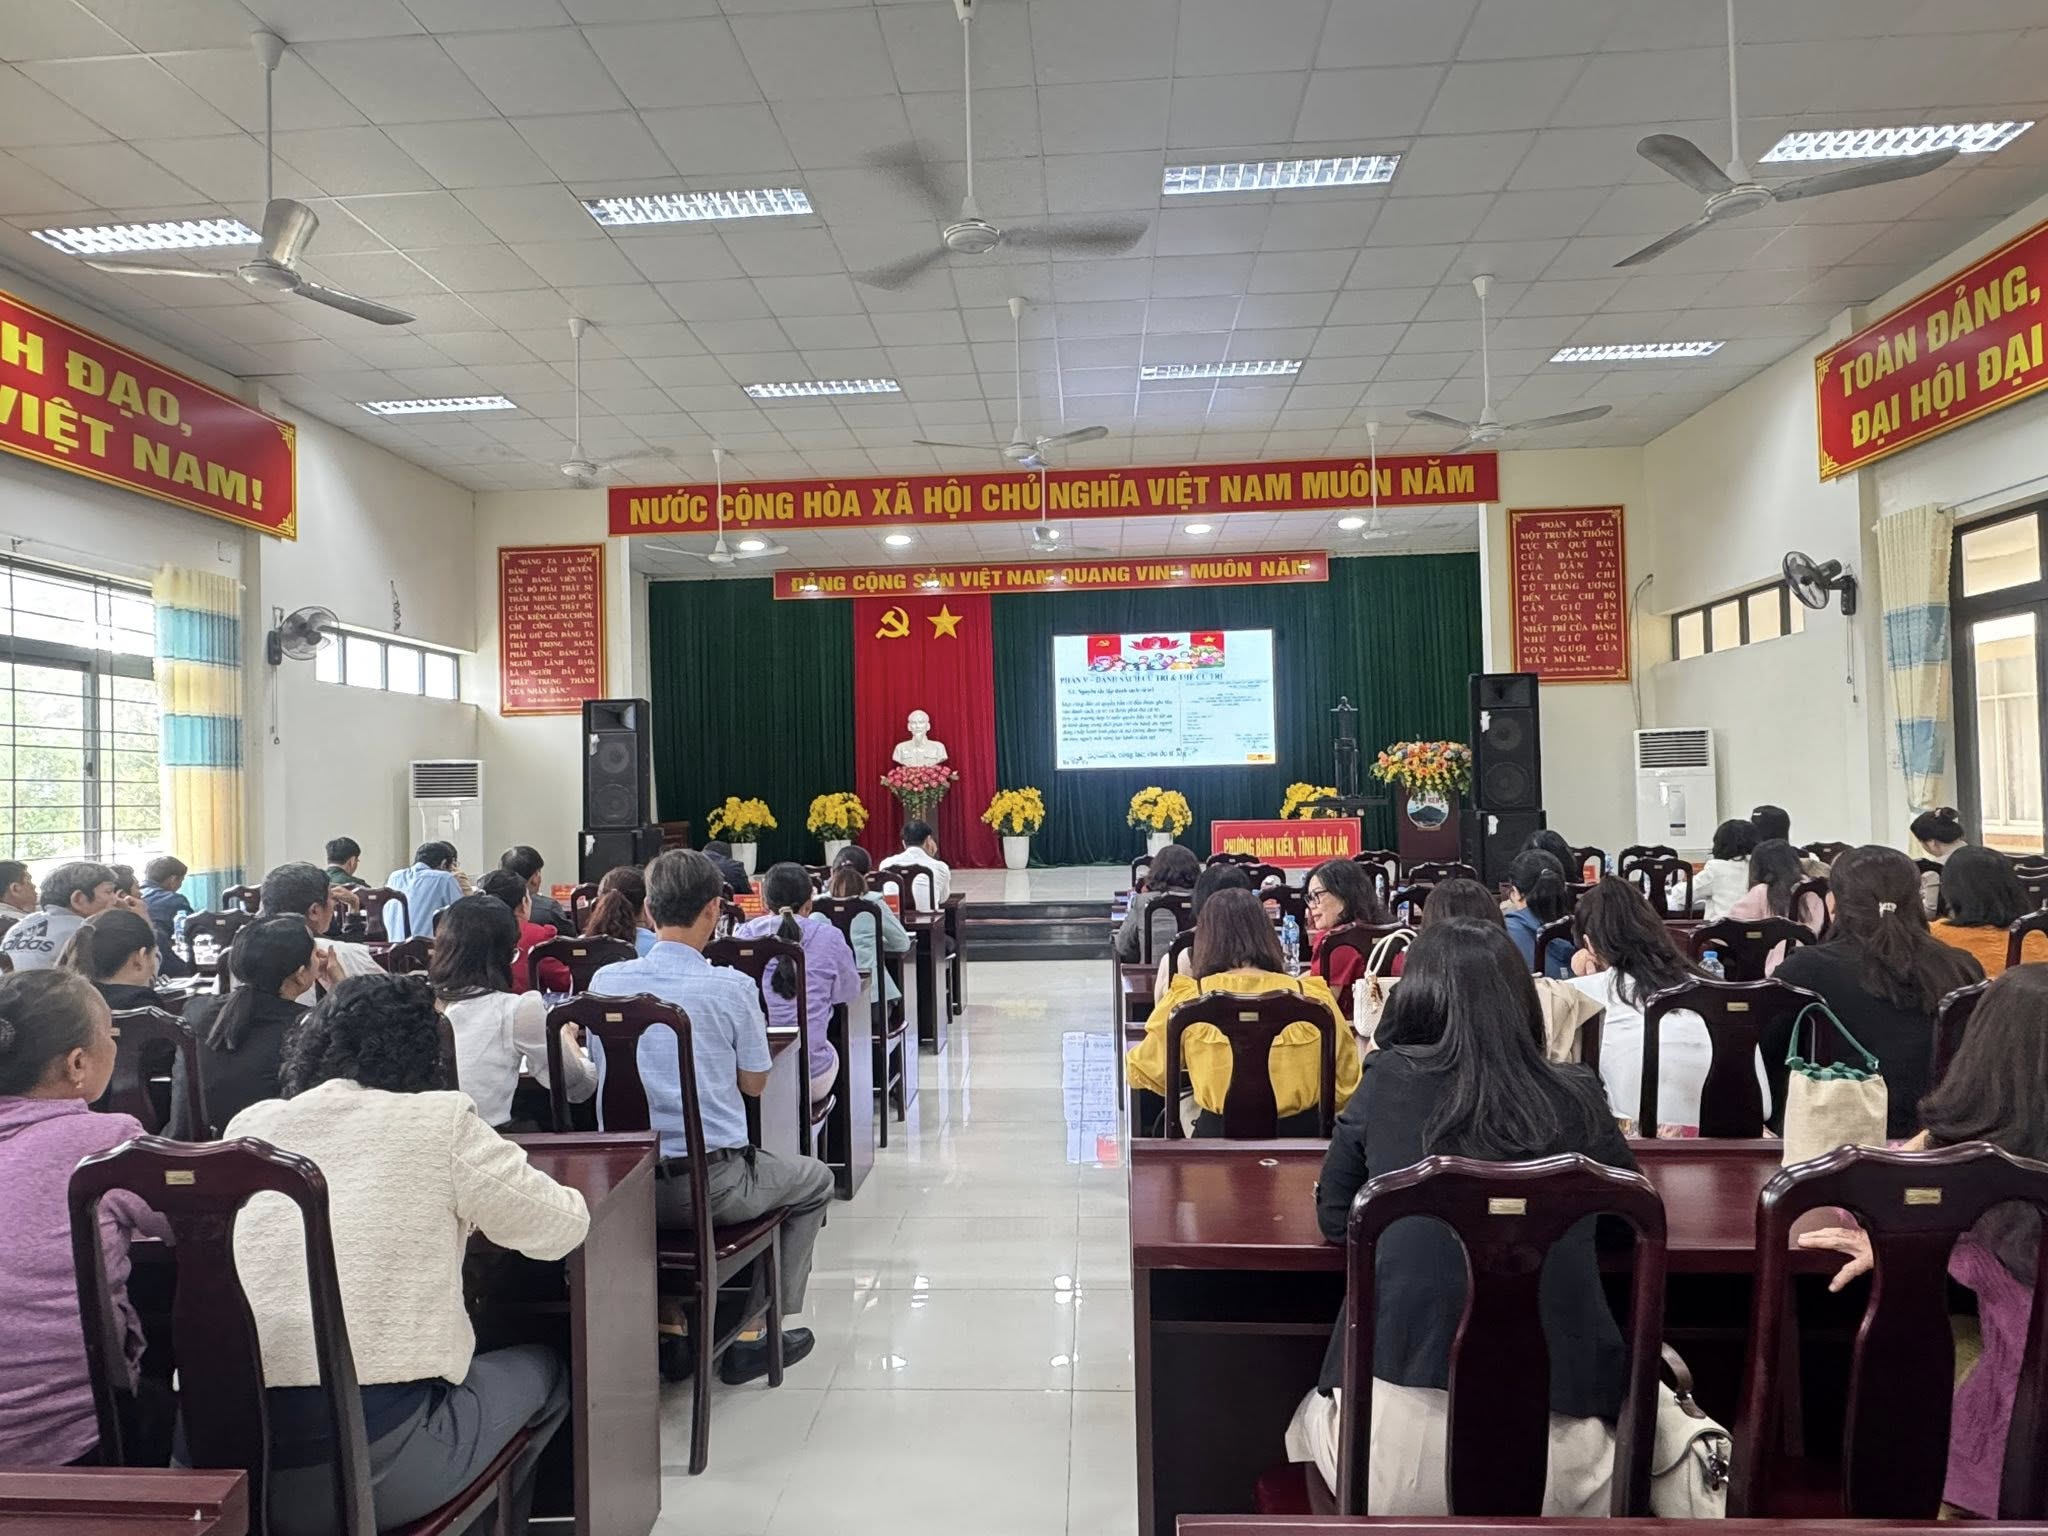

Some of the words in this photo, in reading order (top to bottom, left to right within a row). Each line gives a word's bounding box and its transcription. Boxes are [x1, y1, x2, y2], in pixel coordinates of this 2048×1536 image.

[1840, 325, 1917, 397] TOÀN
[1927, 266, 2040, 353] ĐẢNG,
[65, 350, 192, 437] ĐẠO,
[1851, 393, 1900, 448] ĐẠI
[1910, 361, 1966, 422] HỘI
[1977, 322, 2043, 392] ĐẠI
[133, 433, 262, 511] NAM!
[630, 489, 708, 525] NƯỚC
[718, 487, 794, 527] CỘNG
[804, 483, 861, 519] HÒA
[871, 482, 914, 516] XÃ
[923, 478, 972, 519] HỘI
[982, 474, 1041, 512] CHỦ
[1049, 473, 1140, 510] NGHĨA
[1147, 472, 1210, 510] VIỆT
[1220, 473, 1291, 503] NAM
[1302, 463, 1392, 499] MUÔN
[1400, 459, 1475, 495] NĂM
[791, 572, 846, 592] ĐẢNG
[852, 572, 906, 593] CỘNG
[959, 568, 1002, 589] VIỆT
[1007, 569, 1055, 585] NAM
[1061, 566, 1130, 584] QUANG
[1136, 565, 1184, 581] VINH
[1190, 559, 1252, 579] MUÔN
[1260, 556, 1313, 576] NĂM
[1256, 834, 1275, 857] BÌNH
[1298, 830, 1315, 855] TỈNH
[3, 935, 55, 952] adidas
